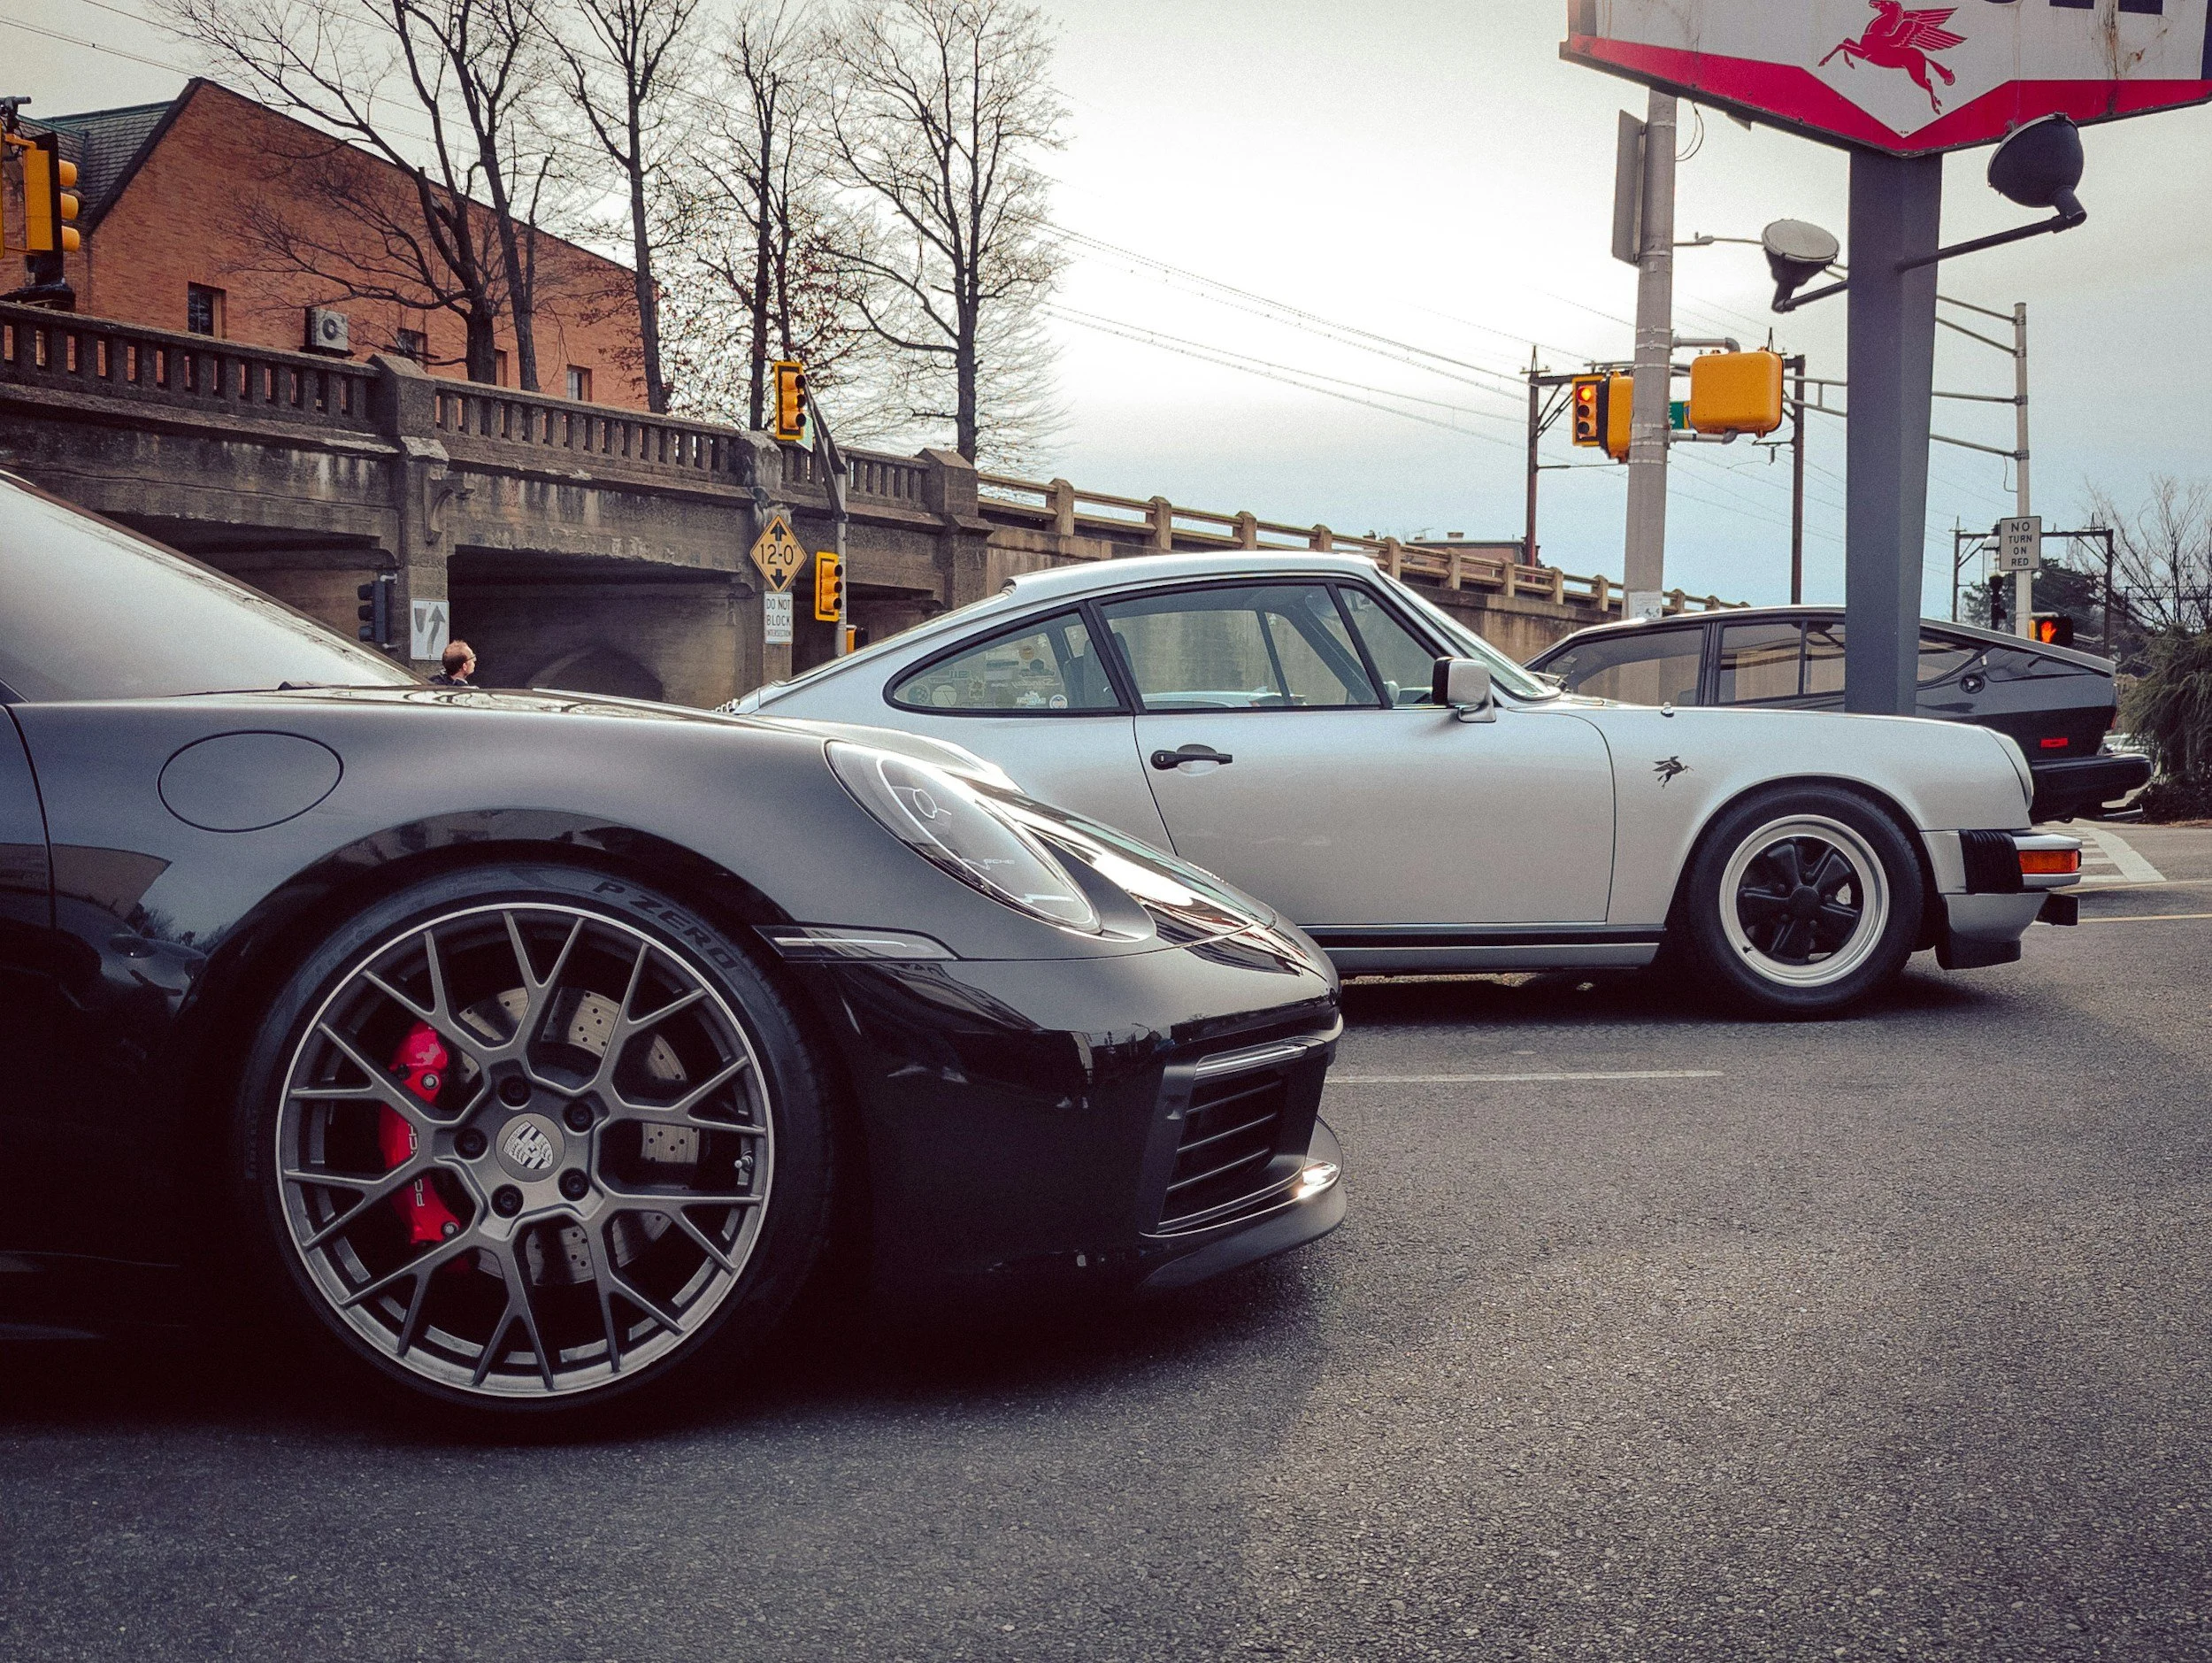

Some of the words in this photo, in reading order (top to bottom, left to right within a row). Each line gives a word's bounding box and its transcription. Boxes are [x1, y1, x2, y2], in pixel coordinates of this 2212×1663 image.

[2011, 521, 2031, 532] NO
[2008, 535, 2032, 544] TURN
[2013, 546, 2027, 555] ON
[2011, 558, 2029, 566] RED
[766, 598, 776, 610] DO
[778, 599, 791, 611] NOT
[766, 614, 791, 627] BLOCK
[592, 881, 626, 894] P
[629, 893, 738, 970] ZERO
